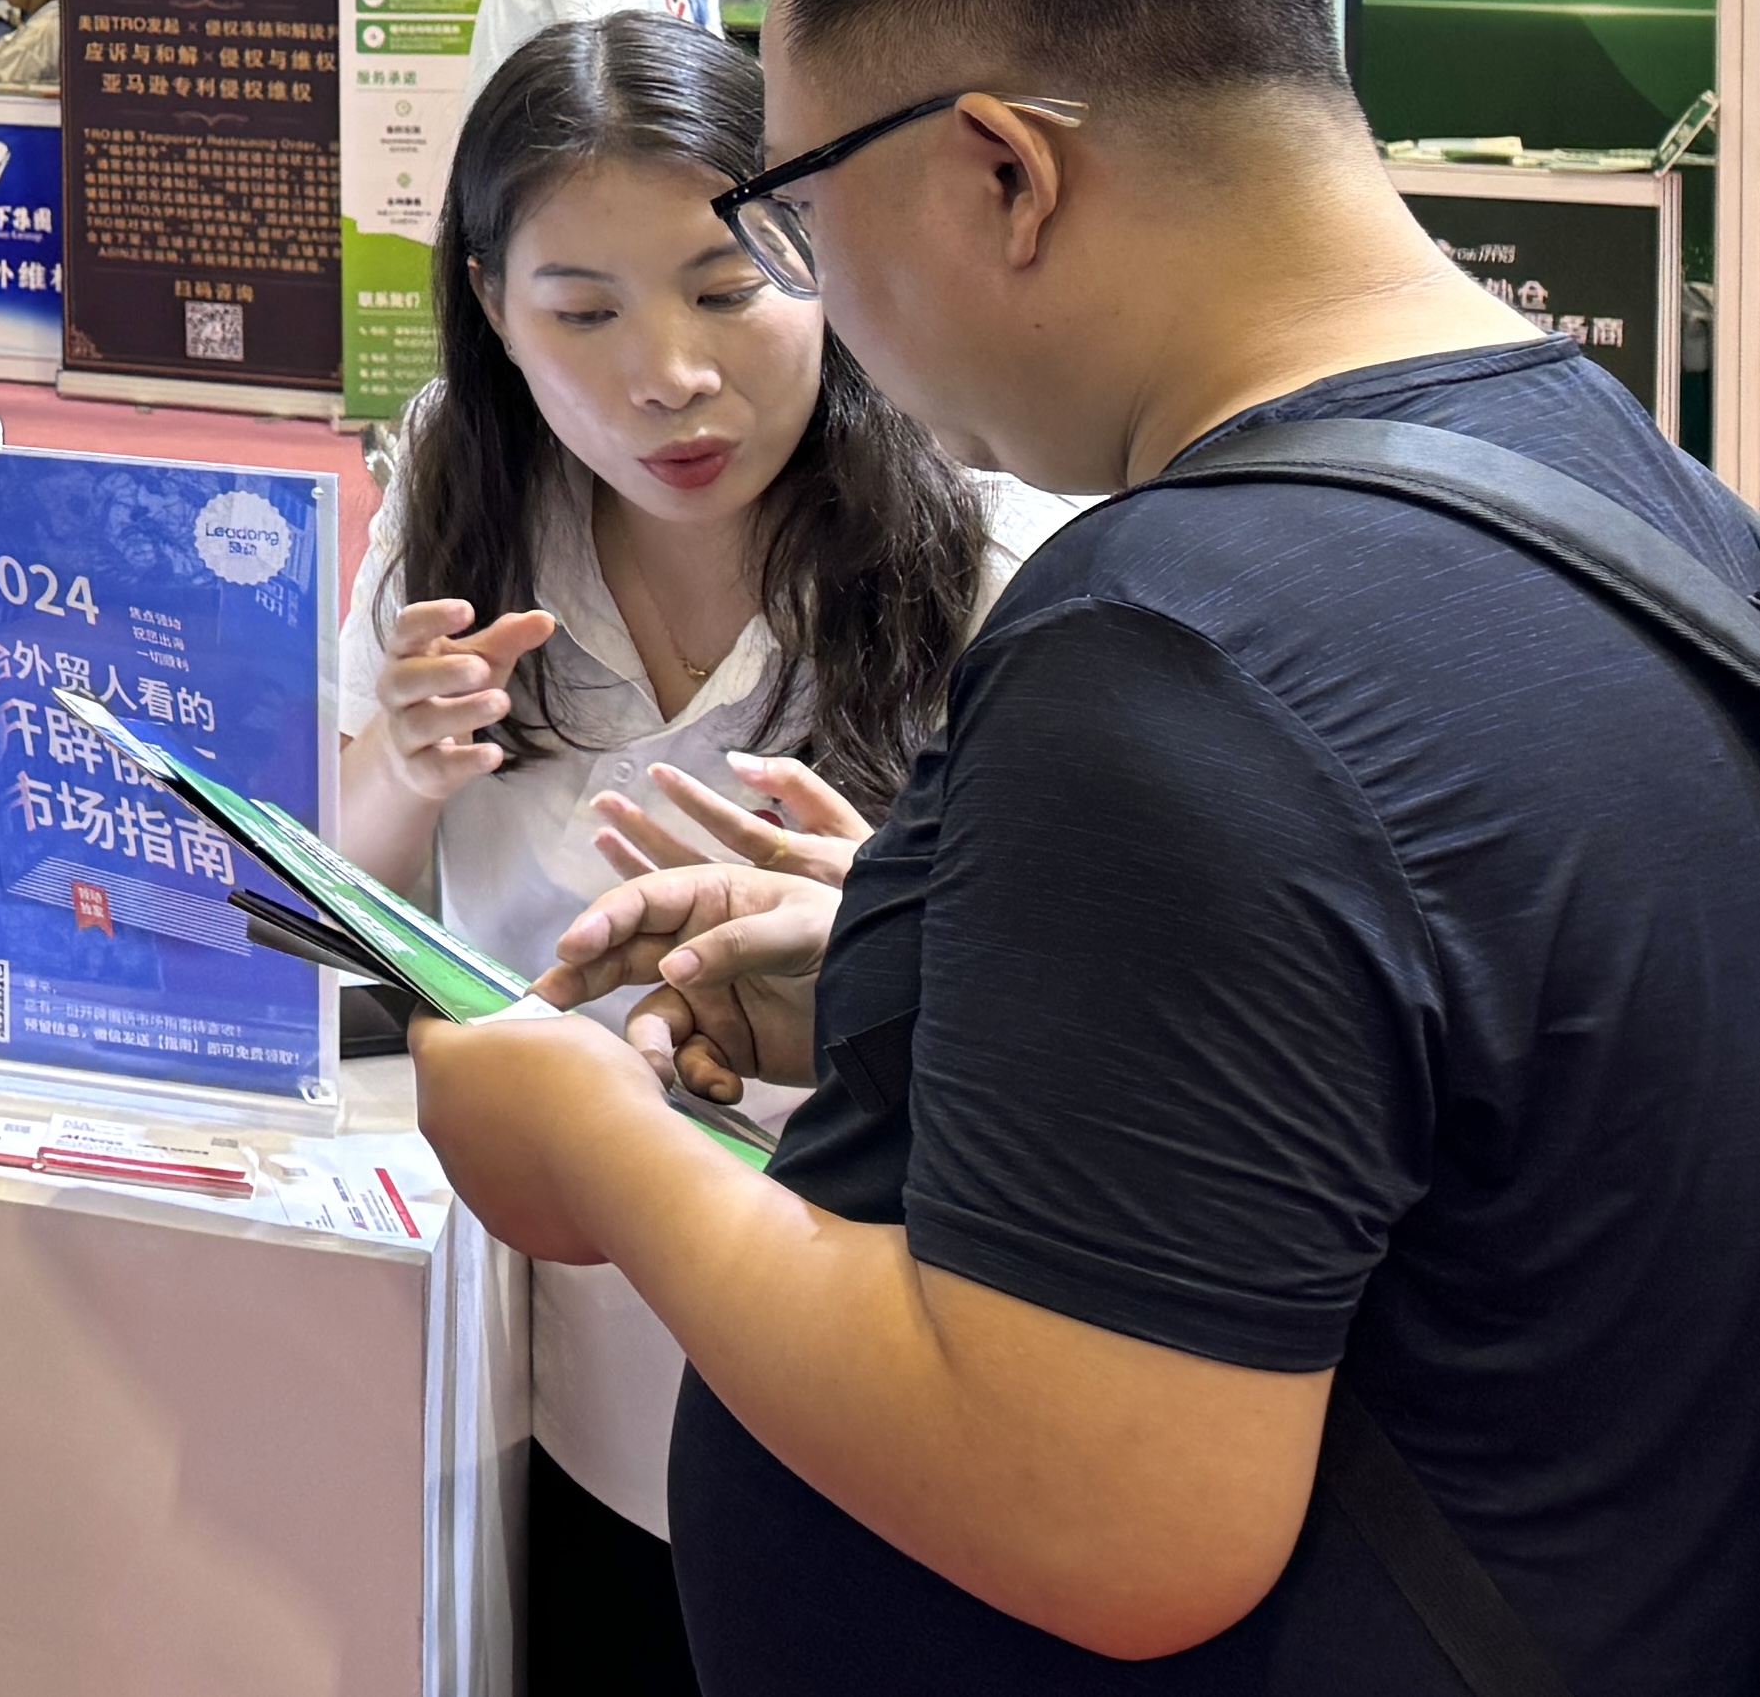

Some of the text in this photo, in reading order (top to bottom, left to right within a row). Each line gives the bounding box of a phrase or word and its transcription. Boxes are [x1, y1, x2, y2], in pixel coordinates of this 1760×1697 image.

[205, 522, 280, 546] Leadong
[12, 769, 236, 886] 市场指南
